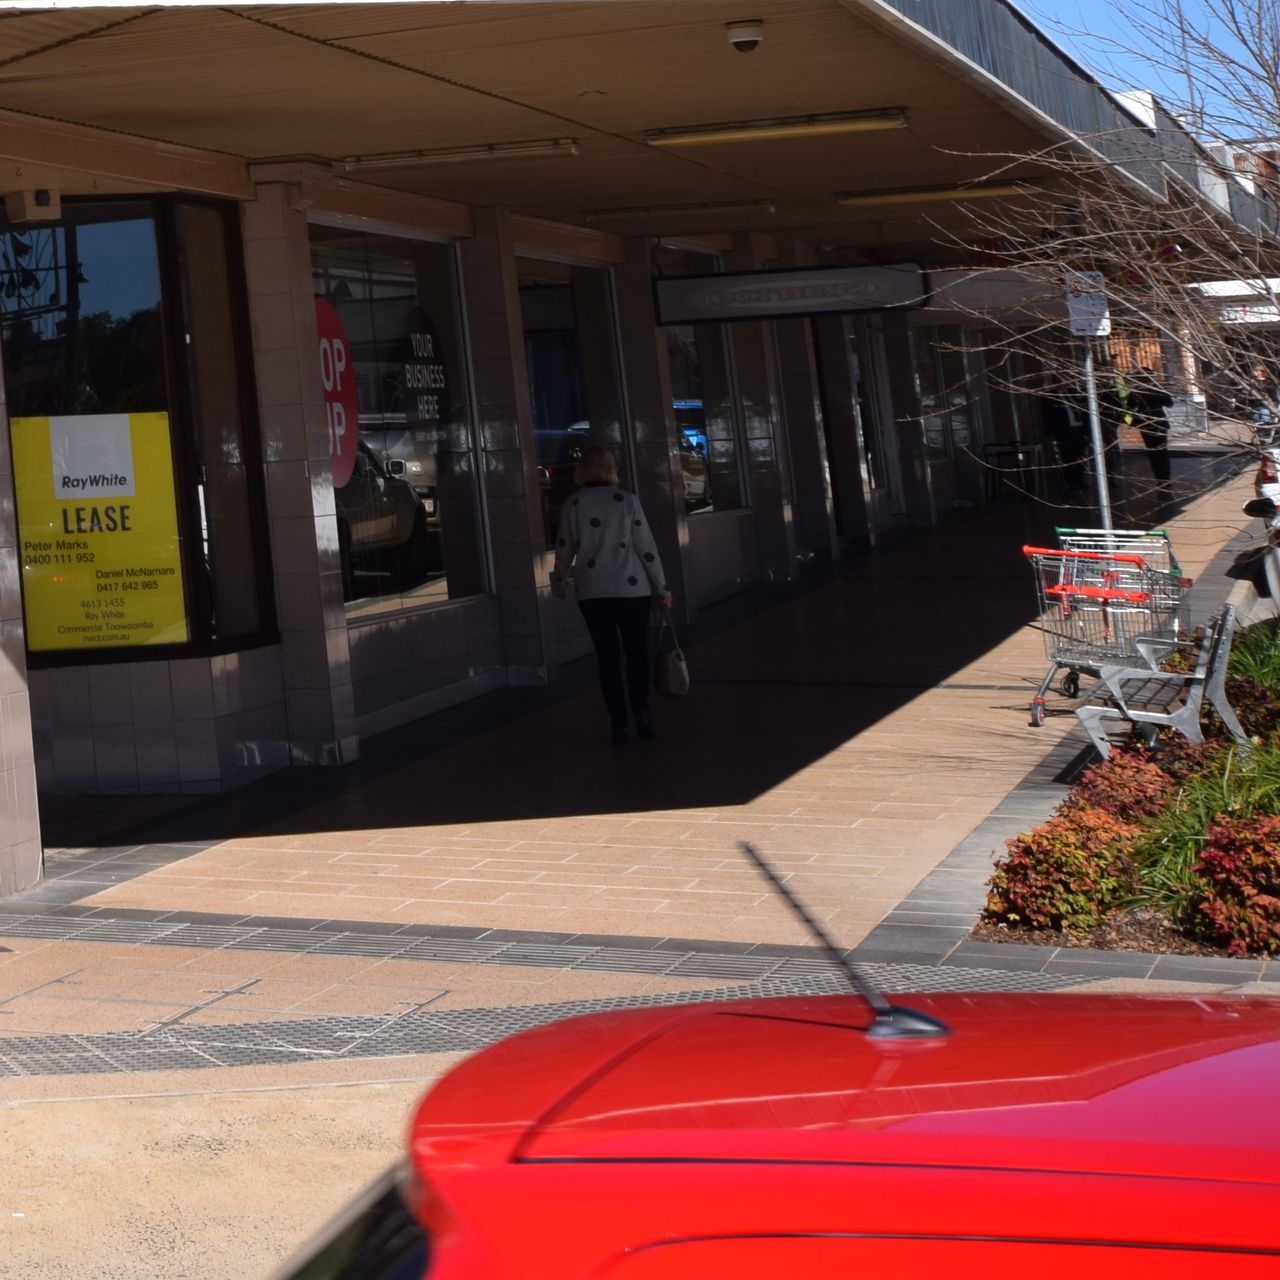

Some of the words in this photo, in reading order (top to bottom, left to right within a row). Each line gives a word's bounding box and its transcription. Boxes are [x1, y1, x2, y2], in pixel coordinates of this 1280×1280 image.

[411, 333, 434, 358] YOUR
[320, 337, 346, 392] OP
[405, 364, 445, 388] BUSINESS
[417, 396, 440, 419] HERE
[62, 505, 132, 534] LEASE
[25, 541, 52, 551] Peter
[56, 540, 88, 550] Marks
[25, 555, 51, 564] 0400
[55, 554, 72, 563] 111
[76, 553, 95, 563] 952
[96, 569, 124, 579] Daniel
[126, 567, 175, 577] McNamara
[96, 583, 118, 592] 0417
[85, 612, 99, 620] Ray
[101, 611, 125, 619] White
[58, 623, 103, 634] Commercial
[106, 621, 154, 631] Toowoomba
